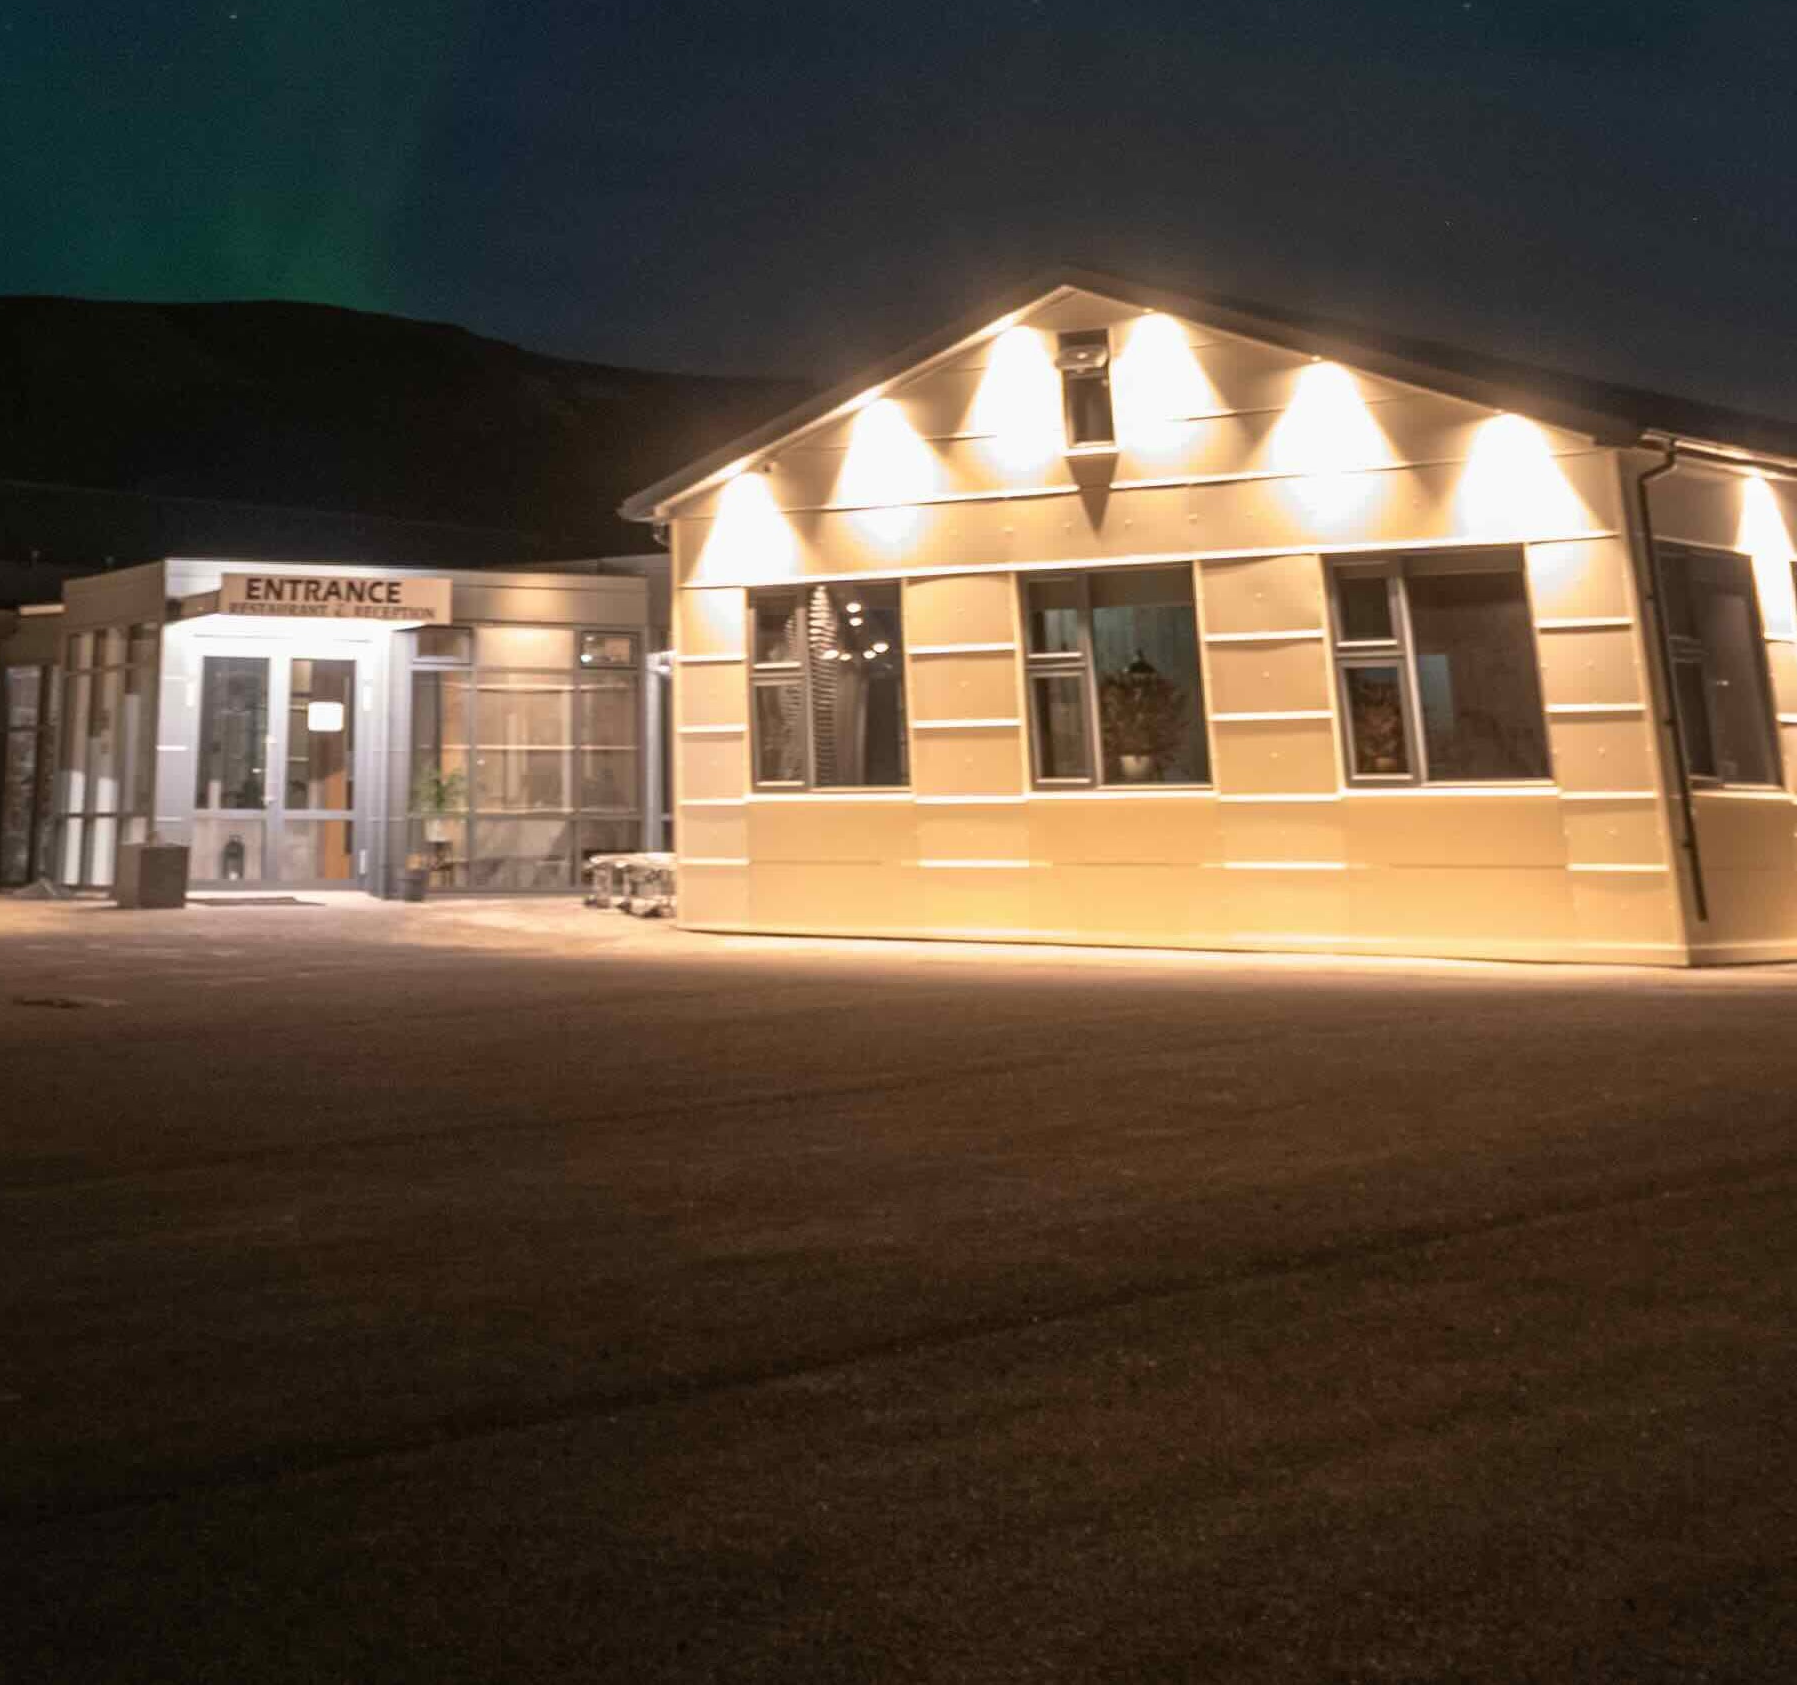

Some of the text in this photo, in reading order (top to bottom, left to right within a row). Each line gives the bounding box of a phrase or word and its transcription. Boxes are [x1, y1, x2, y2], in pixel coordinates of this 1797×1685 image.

[245, 577, 402, 603] ENTRANCE
[228, 601, 328, 616] RESTAURANT
[354, 605, 436, 620] RECEPTION
